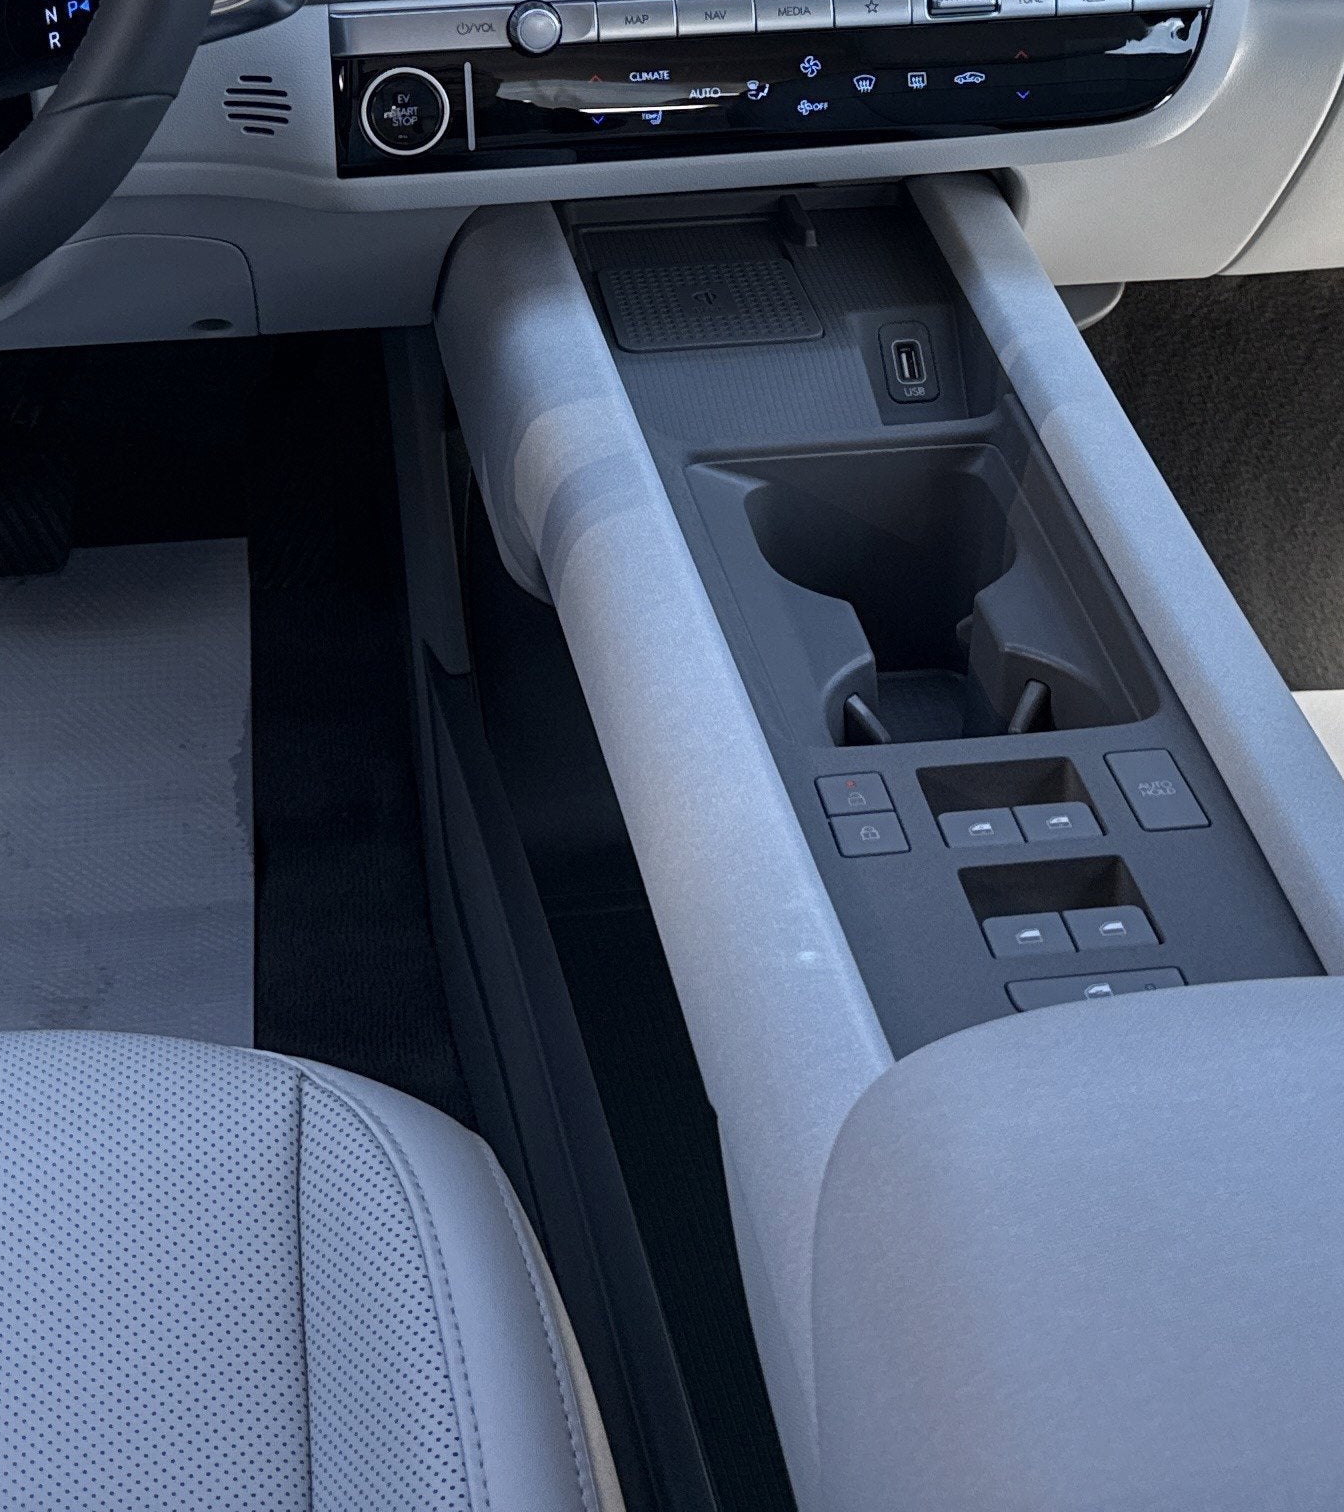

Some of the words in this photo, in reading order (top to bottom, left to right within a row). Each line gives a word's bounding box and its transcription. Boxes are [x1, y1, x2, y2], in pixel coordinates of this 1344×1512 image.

[45, 7, 58, 25] N
[67, 0, 79, 18] P
[704, 10, 727, 21] NAV
[777, 6, 811, 17] MEDIA
[624, 14, 649, 25] MAP
[48, 31, 61, 49] R
[629, 70, 671, 82] CLIMATE
[689, 87, 721, 98] AUTO
[397, 93, 411, 104] EV
[391, 106, 418, 116] START
[392, 116, 418, 127] STOP
[903, 386, 926, 398] USB
[1137, 780, 1173, 790] AUTO
[1140, 787, 1177, 797] HOLD
